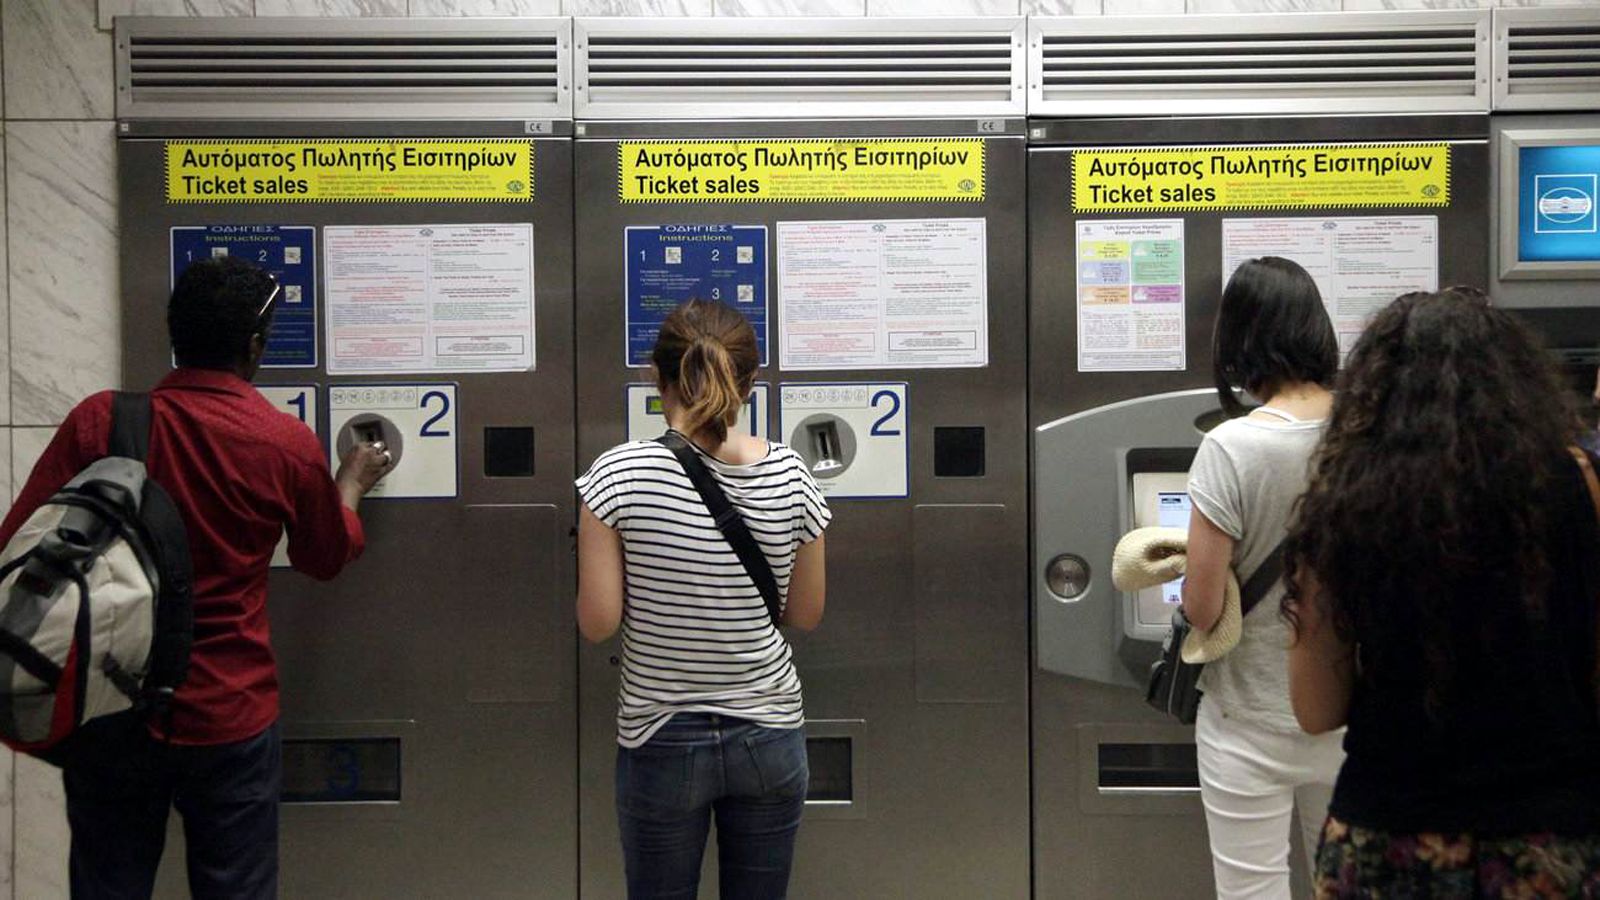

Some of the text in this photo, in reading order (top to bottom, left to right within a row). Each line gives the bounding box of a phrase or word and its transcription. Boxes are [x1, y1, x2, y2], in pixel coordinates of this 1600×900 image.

[181, 147, 517, 172] Αυτόματος Πωλητής Εισιτηρίων
[635, 146, 968, 172] Αυτόματος Πωλητής Εισιτηρίων
[1088, 152, 1433, 180] Αυτόματος Πωλητής Εισιτηρίων
[181, 175, 247, 195] Ticket
[253, 176, 309, 195] sales
[635, 176, 699, 195] Ticket
[705, 176, 761, 195] sales
[1088, 185, 1153, 204] Ticket
[1160, 184, 1216, 203] sales
[205, 234, 281, 243] Instructions
[660, 234, 734, 242] Instructions
[665, 225, 728, 233] ΟΔΗΓΙΕΣ
[186, 250, 193, 262] 1
[257, 249, 267, 262] 2
[639, 249, 647, 262] 1
[711, 249, 720, 262] 2
[711, 288, 720, 300] 3
[287, 391, 306, 423] 1
[419, 390, 450, 437] 2
[869, 390, 901, 436] 2
